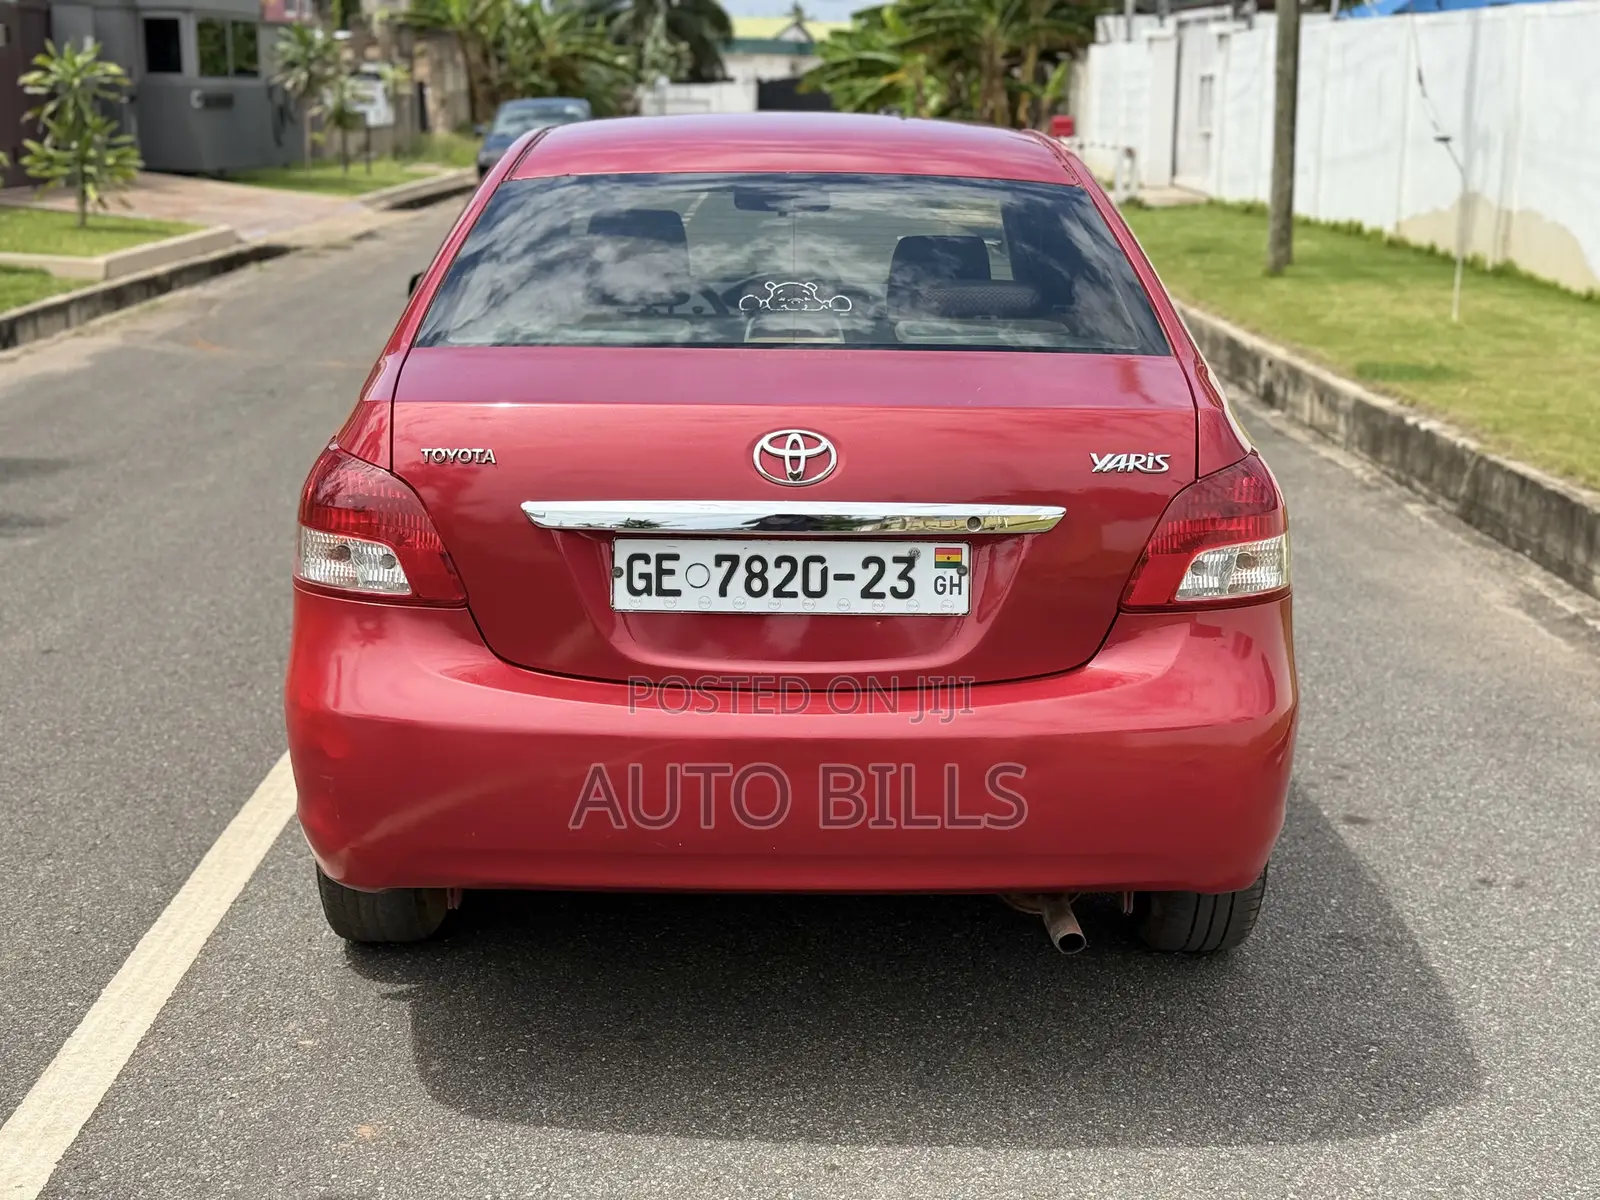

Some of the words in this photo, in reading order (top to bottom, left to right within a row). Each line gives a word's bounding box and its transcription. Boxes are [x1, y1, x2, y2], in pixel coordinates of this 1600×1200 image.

[420, 447, 497, 465] TOYOTA
[626, 553, 682, 597] GE
[714, 554, 916, 600] 7820-23
[933, 575, 963, 596] GH
